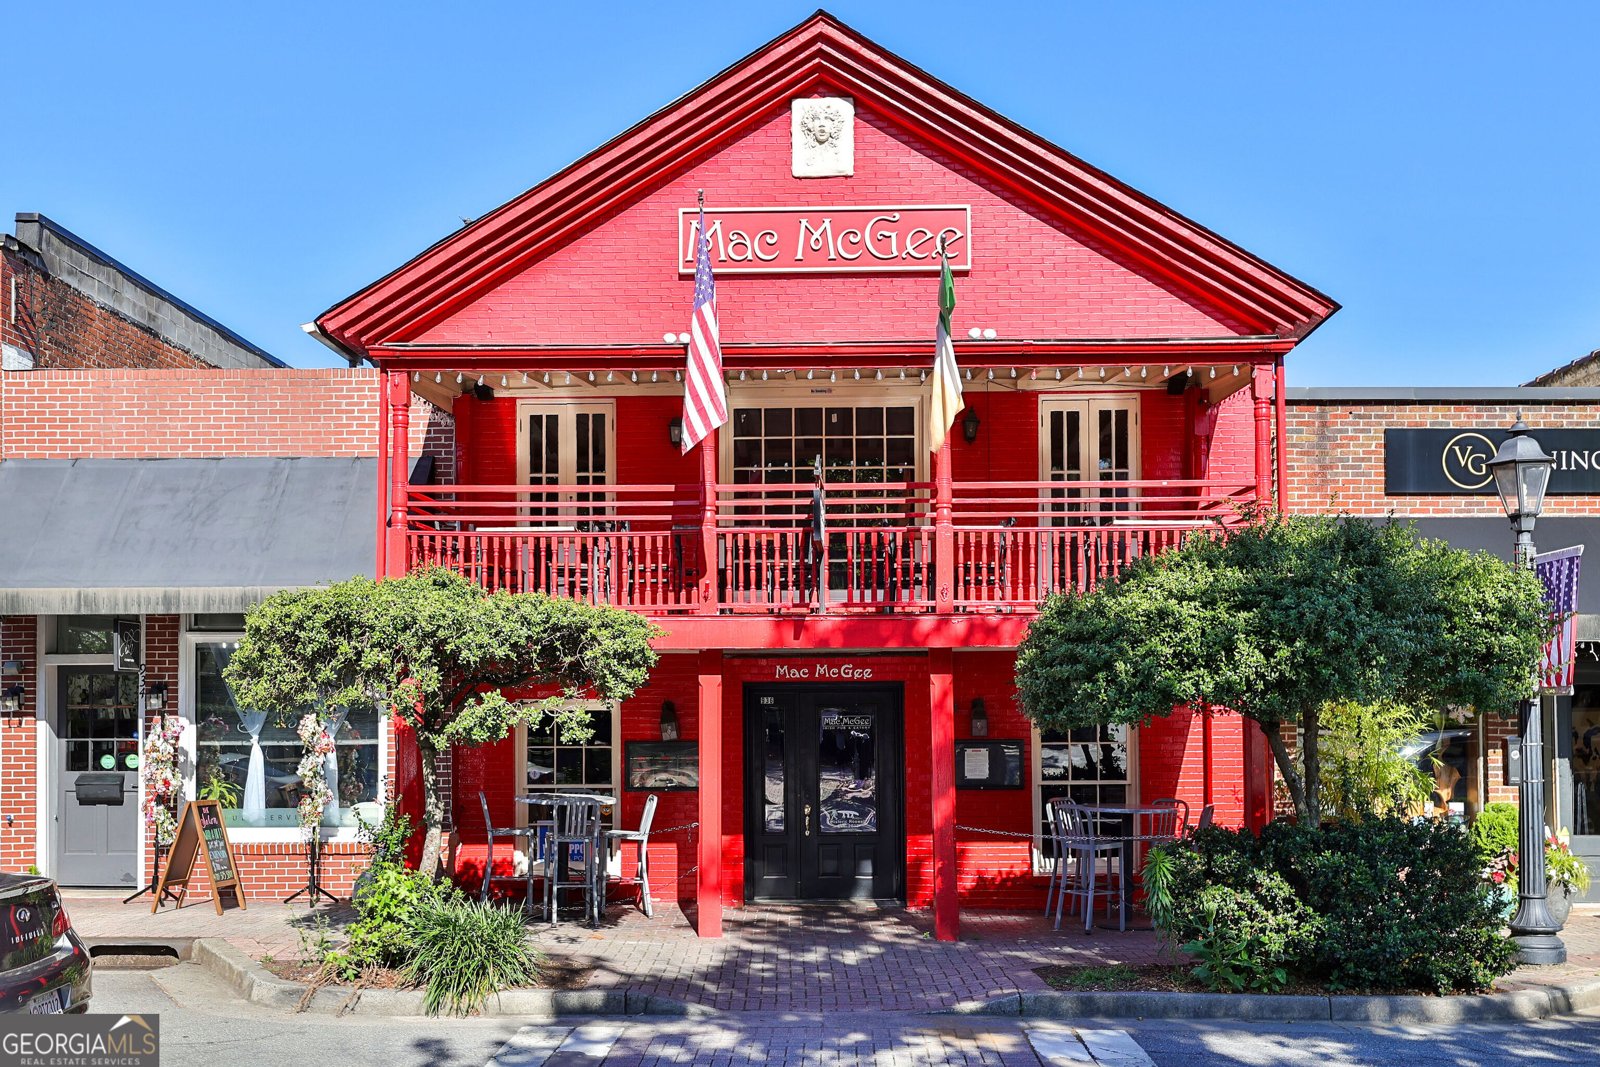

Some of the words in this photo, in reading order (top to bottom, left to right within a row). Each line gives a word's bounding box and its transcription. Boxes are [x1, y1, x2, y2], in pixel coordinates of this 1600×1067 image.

[685, 219, 780, 262] Mac
[794, 212, 964, 262] McGee
[1452, 445, 1486, 475] VG
[775, 665, 809, 678] Mac
[815, 663, 873, 679] McGee
[823, 717, 840, 725] Mac
[842, 716, 870, 725] McGee
